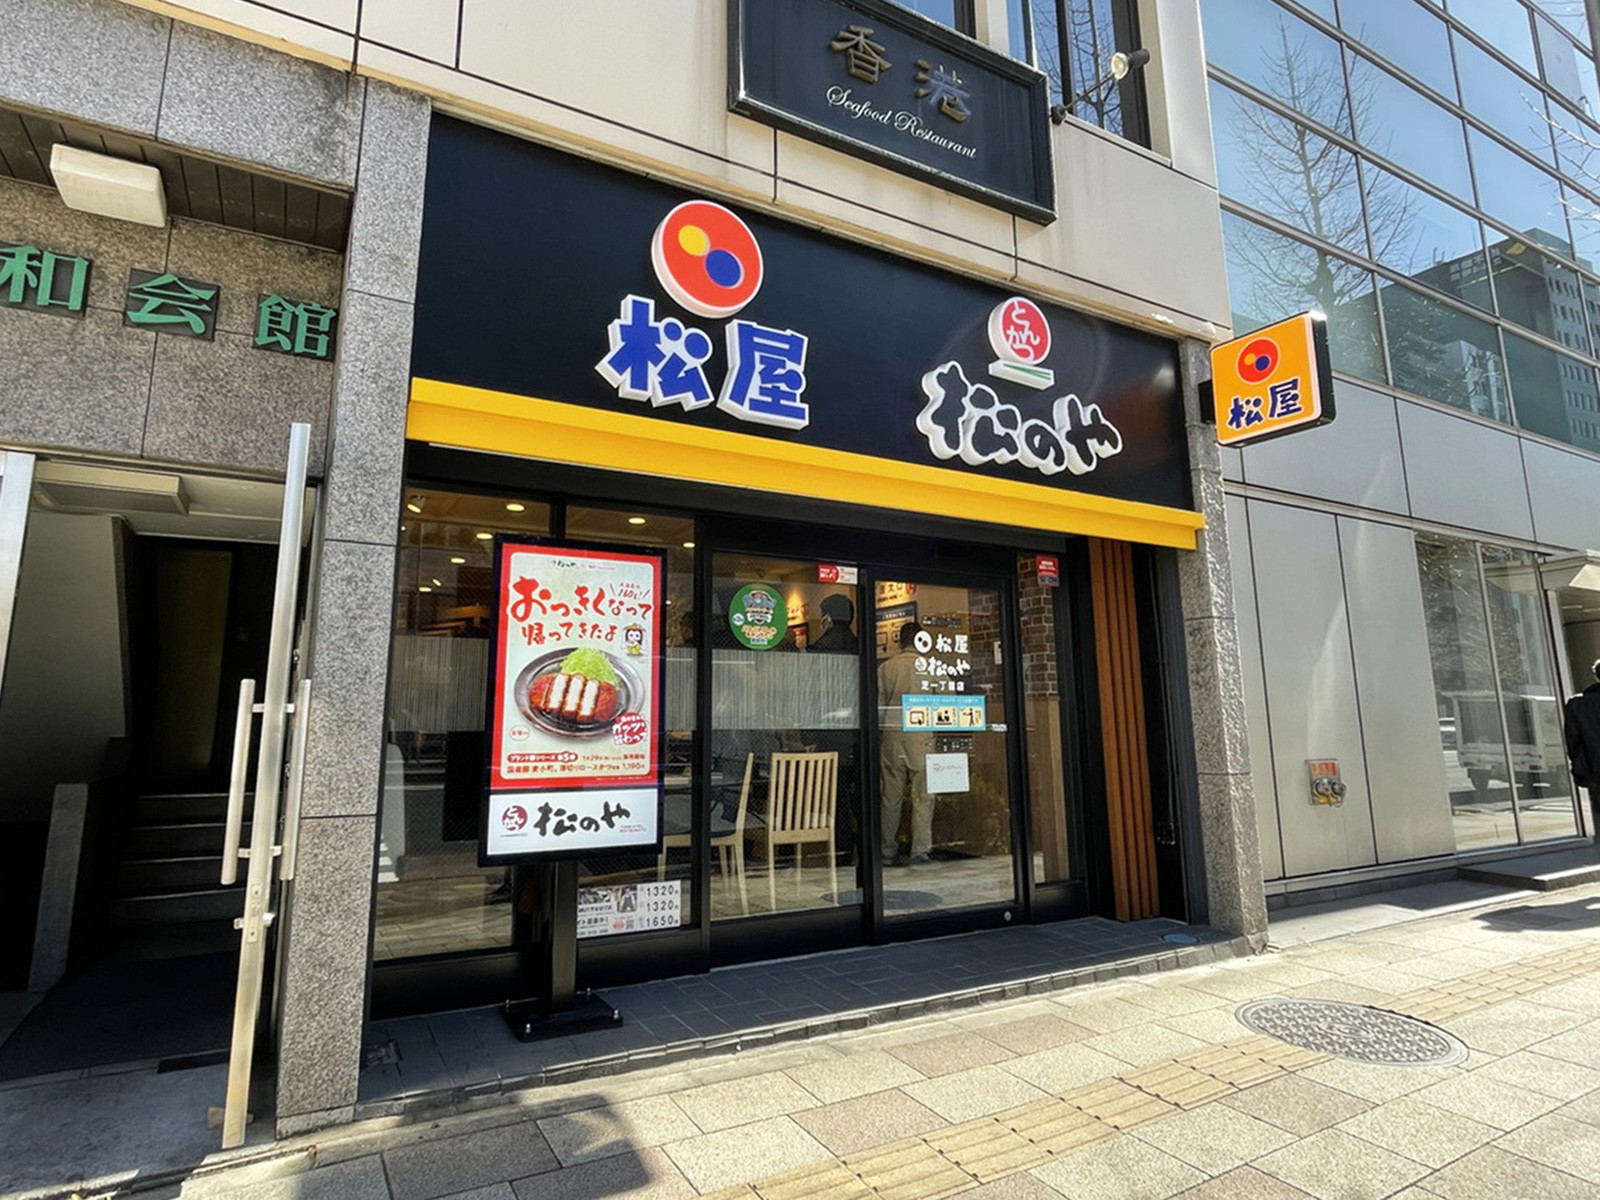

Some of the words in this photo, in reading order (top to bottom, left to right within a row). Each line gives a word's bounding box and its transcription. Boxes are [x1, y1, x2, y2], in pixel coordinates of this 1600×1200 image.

[829, 24, 973, 123] 香港
[826, 85, 892, 125] Seafood
[894, 111, 977, 160] Restaurant
[597, 294, 809, 429] 松屋
[915, 361, 1123, 475] 松のや
[1227, 377, 1304, 430] 松屋
[510, 576, 653, 622] おっきくなって
[522, 622, 618, 646] 帰ってきたよ
[935, 633, 969, 654] 松屋
[927, 656, 971, 677] 松のや
[533, 800, 632, 837] 松のや
